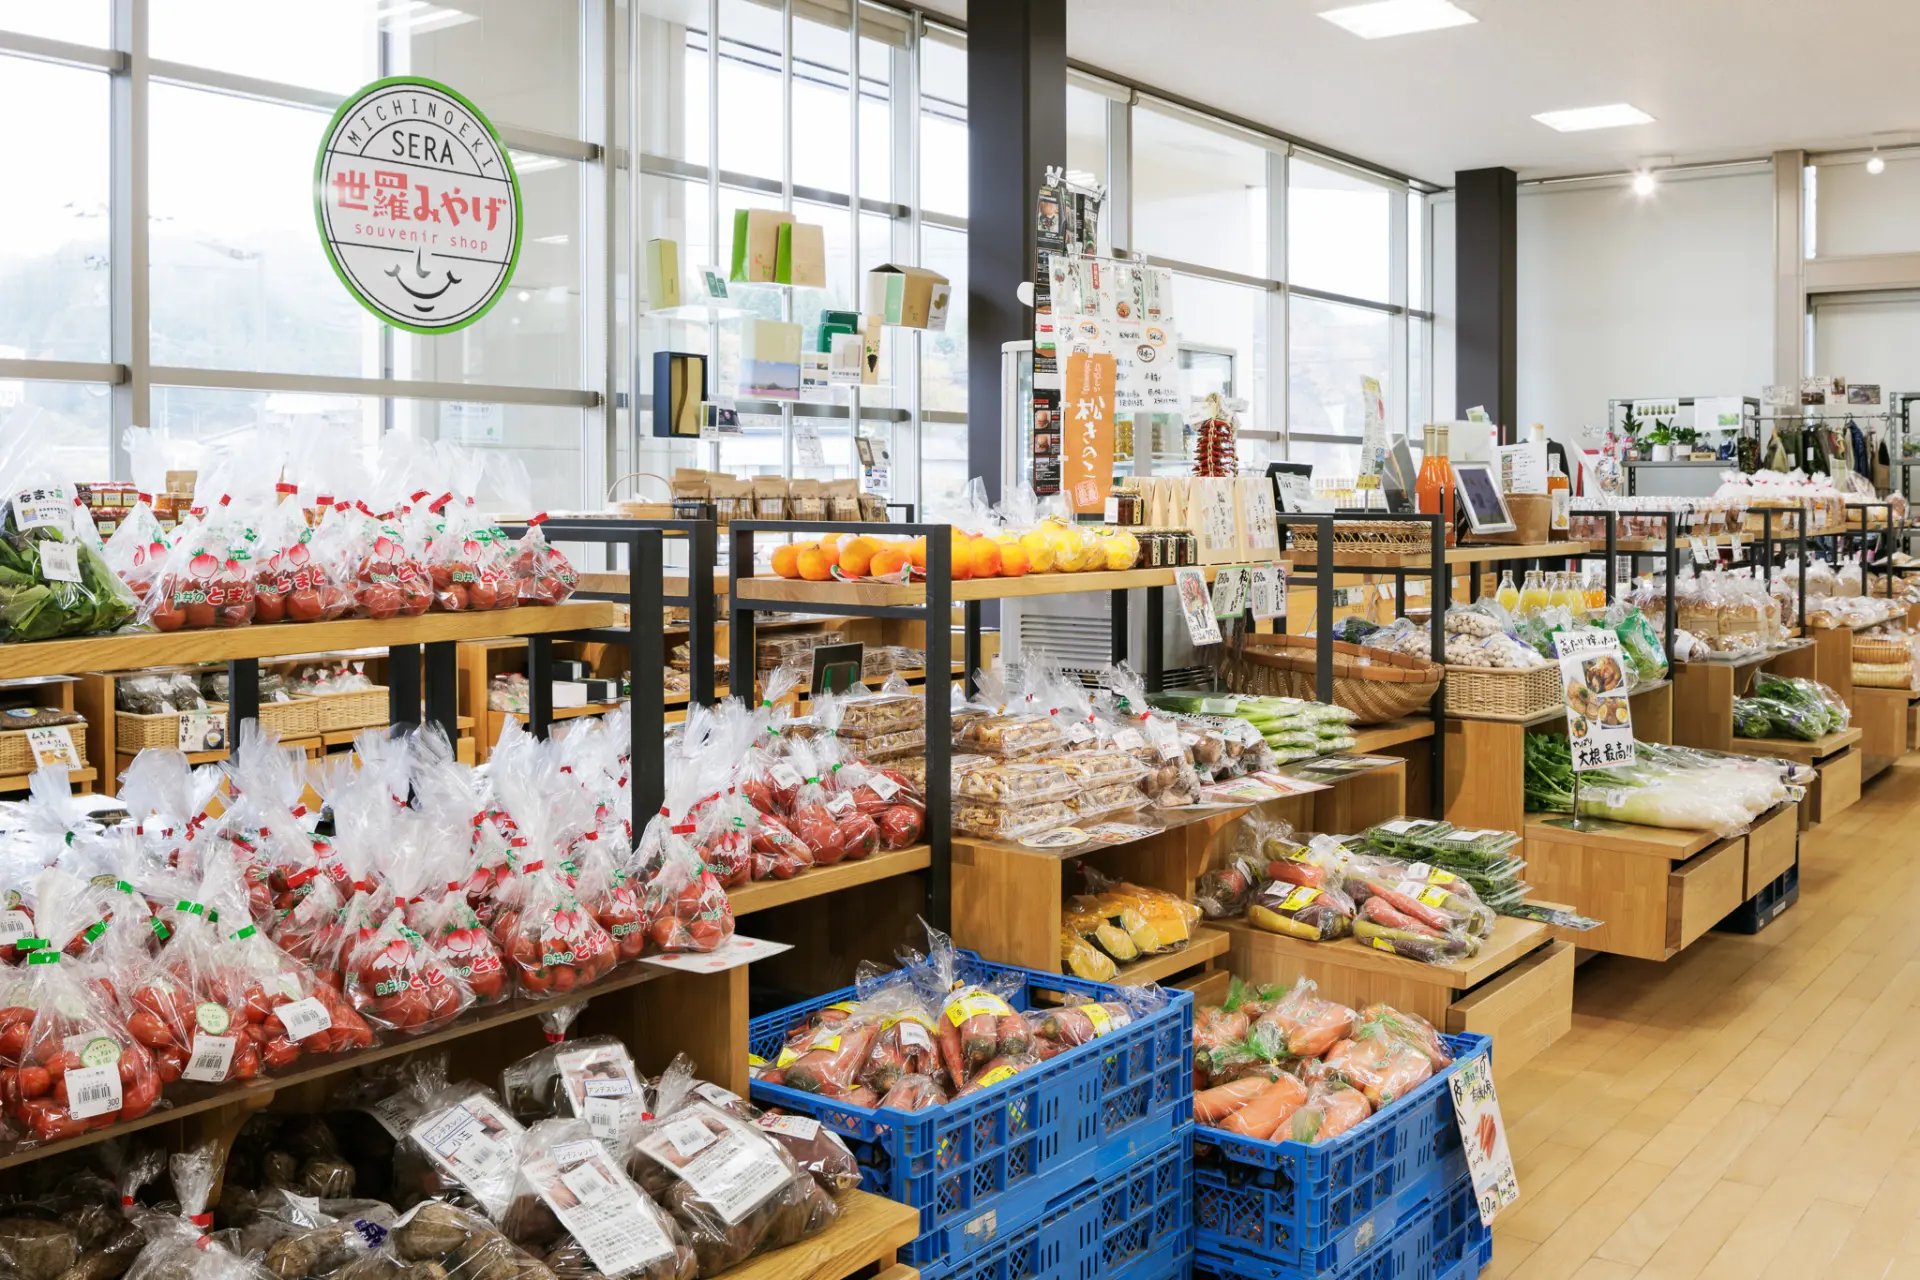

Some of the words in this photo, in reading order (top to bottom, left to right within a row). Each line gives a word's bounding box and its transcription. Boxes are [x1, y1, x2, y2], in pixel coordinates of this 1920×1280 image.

[347, 99, 494, 168] MICHINOEKI
[392, 130, 454, 166] SERA
[332, 169, 507, 231] 世羅みやげ
[355, 223, 438, 244] souvenir
[450, 235, 488, 253] shop
[1578, 748, 1602, 767] 大根
[107, 1097, 120, 1107] 300
